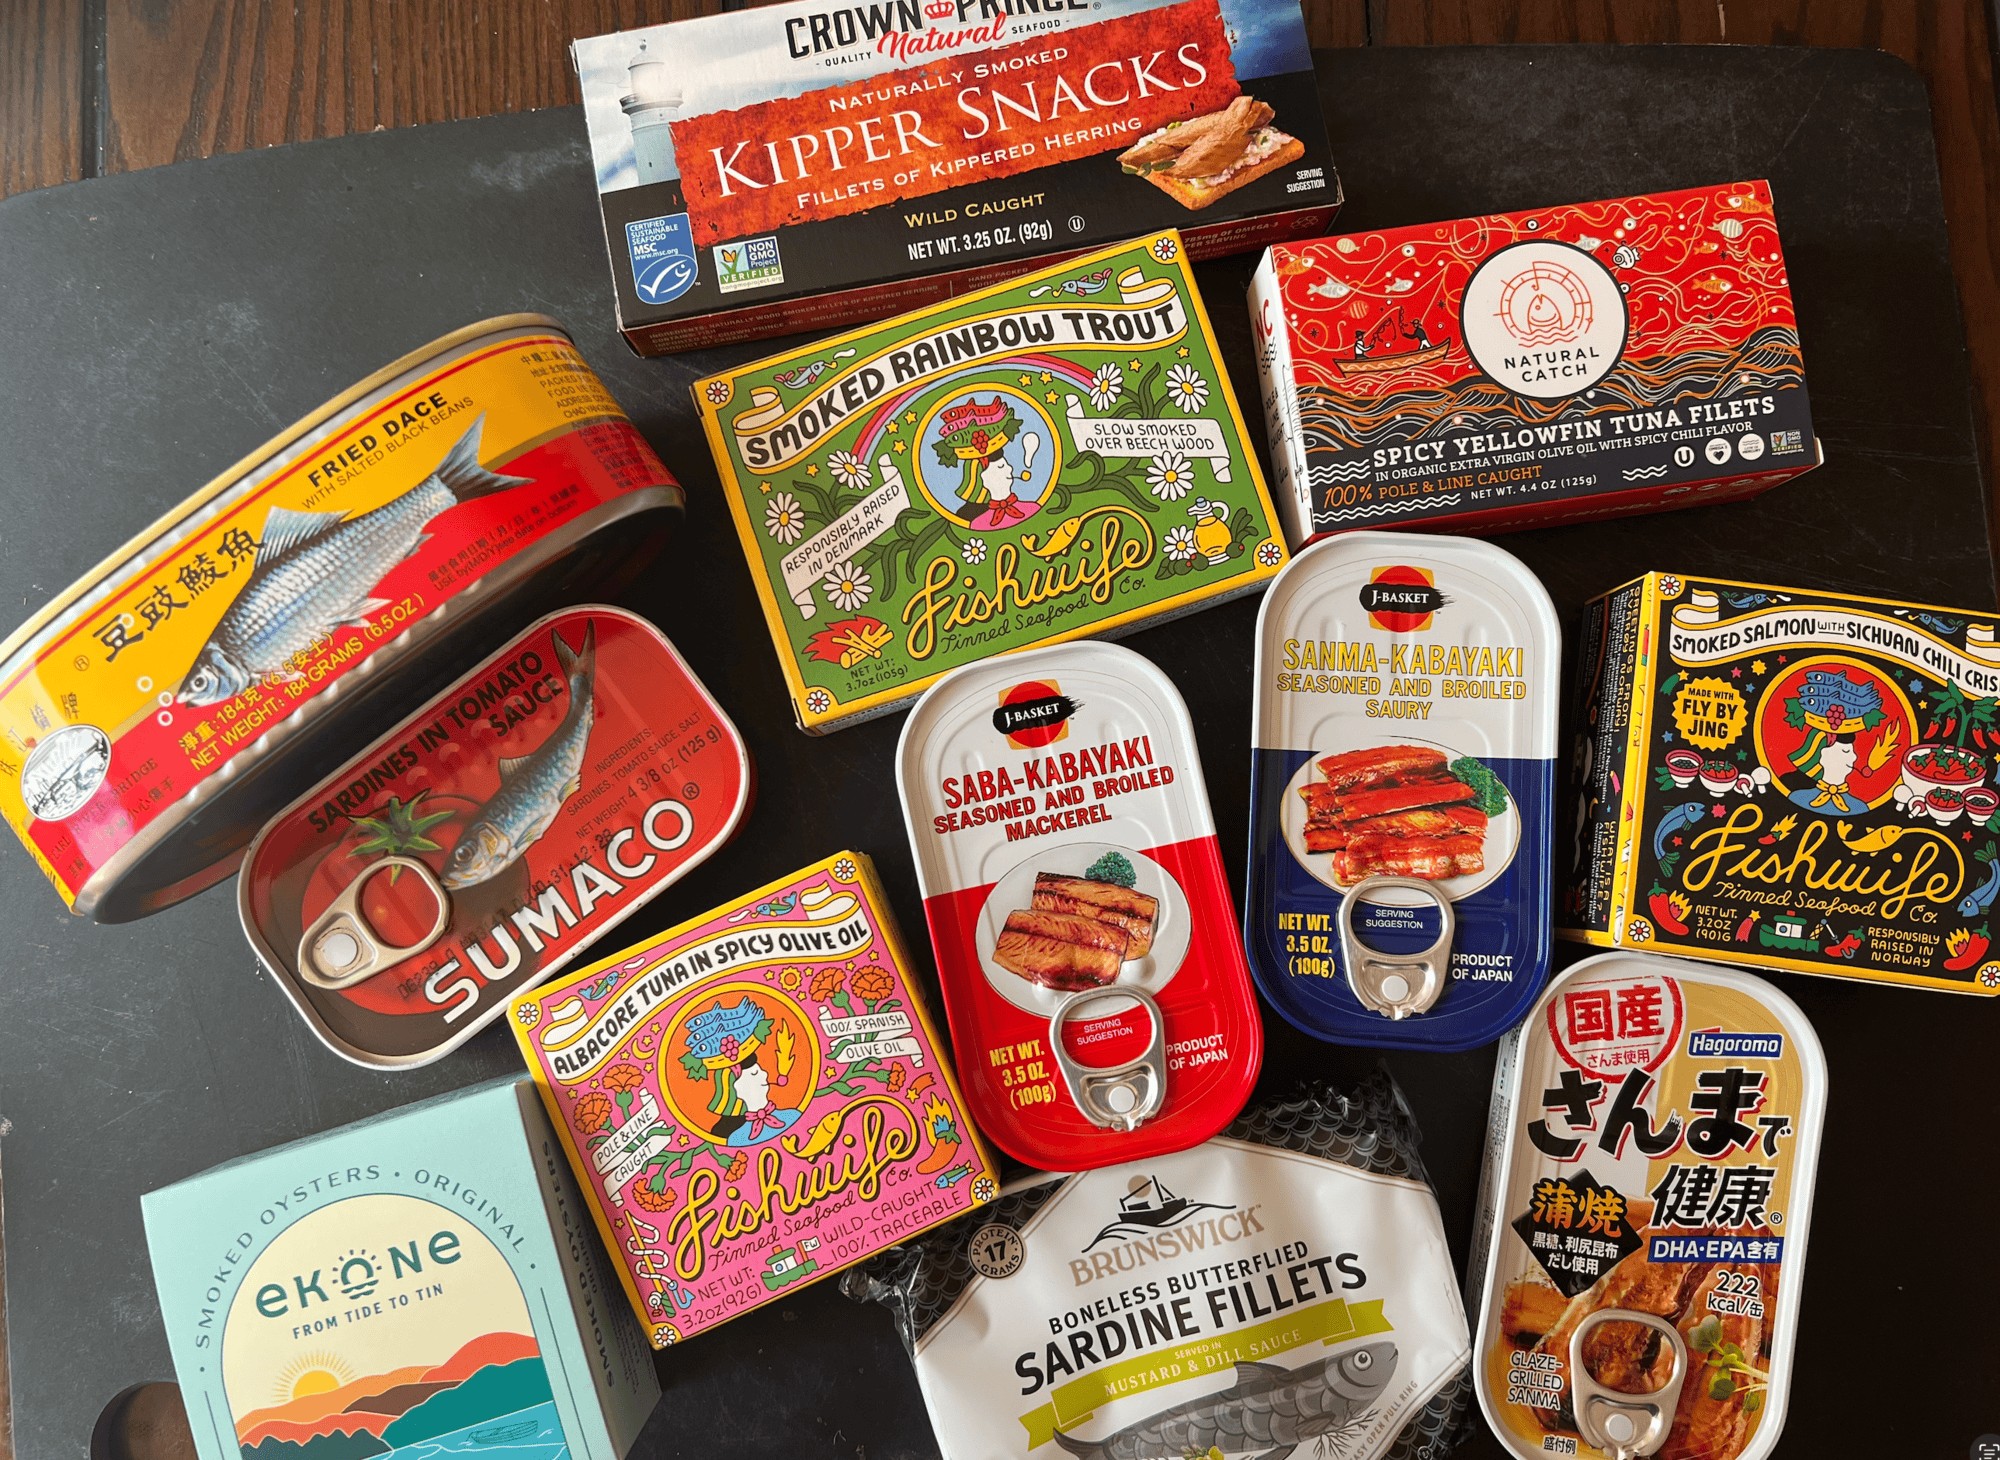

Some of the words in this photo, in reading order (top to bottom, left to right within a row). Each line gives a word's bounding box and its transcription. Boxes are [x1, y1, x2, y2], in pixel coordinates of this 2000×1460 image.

[785, 0, 924, 59] CROWN
[825, 51, 872, 67] QUALITY
[877, 11, 1008, 64] Natural
[1011, 19, 1061, 35] SEAFOOD
[829, 70, 964, 113] NATURALLY
[974, 47, 1069, 79] SMOKED
[707, 107, 943, 198] KIPPER
[957, 41, 1208, 141] SNACKS
[796, 175, 886, 210] FILLETS
[893, 169, 920, 186] OF
[930, 140, 1036, 177] KIPPERED
[1045, 116, 1144, 152] HERRING
[1296, 167, 1324, 182] SERVING
[1286, 177, 1326, 195] SUGGESTION
[903, 207, 958, 230] WILD
[965, 192, 1046, 219] CAUGHT
[629, 220, 666, 232] CERTIFIED
[631, 224, 679, 238] SUSTAINABLE
[632, 233, 667, 246] SEAFOOD
[633, 242, 658, 255] MSC
[634, 248, 679, 261] www.msc.org
[748, 240, 774, 252] NON
[749, 249, 776, 262] GMO
[722, 267, 779, 283] VERIFIED
[750, 257, 777, 268] Project
[1503, 346, 1601, 370] NATURAL
[747, 367, 886, 466] SMOKED
[895, 313, 1057, 385] RAINBOW
[1062, 304, 1178, 341] TROUT
[1521, 362, 1589, 384] CATCH
[307, 434, 379, 488] FRIED
[382, 391, 449, 435] DACE
[1094, 422, 1135, 436] SLOW
[1138, 423, 1197, 438] SMOKED
[1373, 440, 1446, 468] SPICY
[1452, 418, 1603, 457] YELLOWFIN
[1610, 409, 1683, 435] TUNA
[1688, 396, 1775, 425] FILETS
[301, 484, 337, 510] WITH
[337, 448, 385, 487] SALTED
[386, 420, 431, 454] BLACK
[429, 397, 474, 427] BEANS
[1085, 436, 1123, 450] OVER
[1125, 437, 1170, 451] BEECH
[1172, 437, 1215, 453] WOOD
[1375, 471, 1390, 482] IN
[1392, 462, 1448, 479] ORGANIC
[1449, 456, 1491, 473] EXTRA
[1492, 450, 1536, 469] VIRGIN
[1537, 445, 1574, 459] OLIVE
[1576, 441, 1597, 455] OIL
[1599, 436, 1633, 451] WITH
[1634, 432, 1671, 447] SPICY
[1671, 426, 1704, 442] CHILI
[1706, 421, 1754, 437] FLAVOR
[1324, 483, 1373, 509] 100%
[1378, 481, 1419, 500] POLE
[1422, 481, 1435, 493] &
[1437, 473, 1474, 491] LINE
[1477, 465, 1543, 485] CAUGHT
[784, 514, 861, 577] RESPONSIBLY
[861, 483, 901, 521] RAISED
[806, 558, 824, 577] IN
[822, 515, 885, 564] DENMARK
[93, 526, 266, 664] 豆豉鯪魚
[901, 504, 1157, 660] Fishwife
[1372, 590, 1429, 606] J-BASKET
[1282, 638, 1525, 678] SANMA-KABAYAKI
[1672, 633, 1741, 655] SMOKED
[1743, 616, 1816, 644] SALMON
[1817, 620, 1845, 633] WITH
[1846, 621, 1919, 659] SICHUAN
[1922, 646, 1961, 680] CHILI
[489, 673, 563, 737] SAUCE
[1688, 688, 1711, 698] MADE
[1712, 690, 1735, 701] WITH
[1004, 703, 1060, 726] J-BASKET
[1365, 700, 1433, 720] SAURY
[1682, 698, 1713, 718] FLY
[1716, 701, 1739, 721] BY
[309, 739, 419, 834] SARDINES
[420, 722, 447, 754] IN
[446, 651, 544, 731] TOMATO
[1688, 720, 1729, 740] JING
[567, 780, 613, 817] SARDINES,
[611, 754, 649, 784] TOMATO
[649, 731, 680, 756] SAUCE,
[679, 712, 701, 731] SALT
[595, 728, 653, 774] INGREDIENTS:
[943, 736, 1154, 809] SABA-KABAYAKI
[934, 796, 1036, 834] SEASONED
[1044, 786, 1085, 811] AND
[1093, 766, 1174, 799] BROILED
[1005, 803, 1112, 841] MACKEREL
[422, 798, 694, 1025] SUMACO
[1867, 926, 1940, 945] RESPONSIBLY
[1870, 939, 1914, 953] RAISED
[1918, 943, 1934, 956] IN
[1870, 951, 1931, 969] NORWAY
[554, 1001, 637, 1073] ALBACORE
[637, 965, 686, 1005] TUNA
[687, 950, 713, 976] IN
[714, 936, 775, 964] SPICY
[779, 932, 838, 953] OLIVE
[842, 919, 867, 946] OIL
[825, 1019, 853, 1032] 100%
[855, 1015, 906, 1029] SPANISH
[1083, 1018, 1122, 1034] SERVING
[1565, 984, 1664, 1044] 国産
[1077, 1026, 1134, 1046] SUGGESTION
[1166, 1034, 1224, 1055] PRODUCT
[1691, 1035, 1779, 1055] Hagoromo
[1169, 1056, 1187, 1070] OF
[1189, 1048, 1229, 1067] JAPAN
[1586, 1048, 1651, 1070] さんま使用
[1527, 1068, 1793, 1162] さんまで
[668, 1094, 920, 1280] Fishwife
[1650, 1164, 1775, 1230] 健康
[822, 1185, 934, 1242] WILD-CAUGHT
[1532, 1183, 1627, 1237] 蒲焼
[973, 1229, 1018, 1256] PROTEIN
[984, 1240, 1006, 1262] 17
[1068, 1208, 1265, 1288] BRUNSWICK
[1532, 1230, 1618, 1260] 黒糖、利尻昆布
[194, 1229, 255, 1351] SMOKED
[259, 1164, 382, 1227] OYSTERS
[414, 1168, 524, 1255] ORIGINAL
[981, 1255, 1020, 1275] GRAMS
[1547, 1254, 1600, 1277] だし使用
[1049, 1281, 1161, 1336] BONELESS
[1165, 1239, 1310, 1294] BUTTERFLIED
[1715, 1271, 1760, 1298] 222
[293, 1316, 338, 1340] FROM
[344, 1303, 383, 1324] TIDE
[389, 1295, 409, 1312] TO
[415, 1283, 445, 1302] TIN
[1014, 1294, 1202, 1396] SARDINE
[1210, 1252, 1368, 1329] FILLETS
[1103, 1365, 1183, 1397] MUSTARD
[1203, 1349, 1246, 1368] DILL
[1249, 1329, 1303, 1355] SAUCE
[1174, 1344, 1210, 1361] SERVED
[1210, 1340, 1222, 1351] IN
[1510, 1351, 1562, 1372] GLAZE-
[1508, 1369, 1563, 1391] GRILLED
[1366, 1421, 1385, 1445] OPEN
[1383, 1401, 1402, 1422] PULL
[1399, 1380, 1418, 1401] RING
[1507, 1386, 1561, 1411] SANMA
[1543, 1434, 1577, 1454] 盛付例
